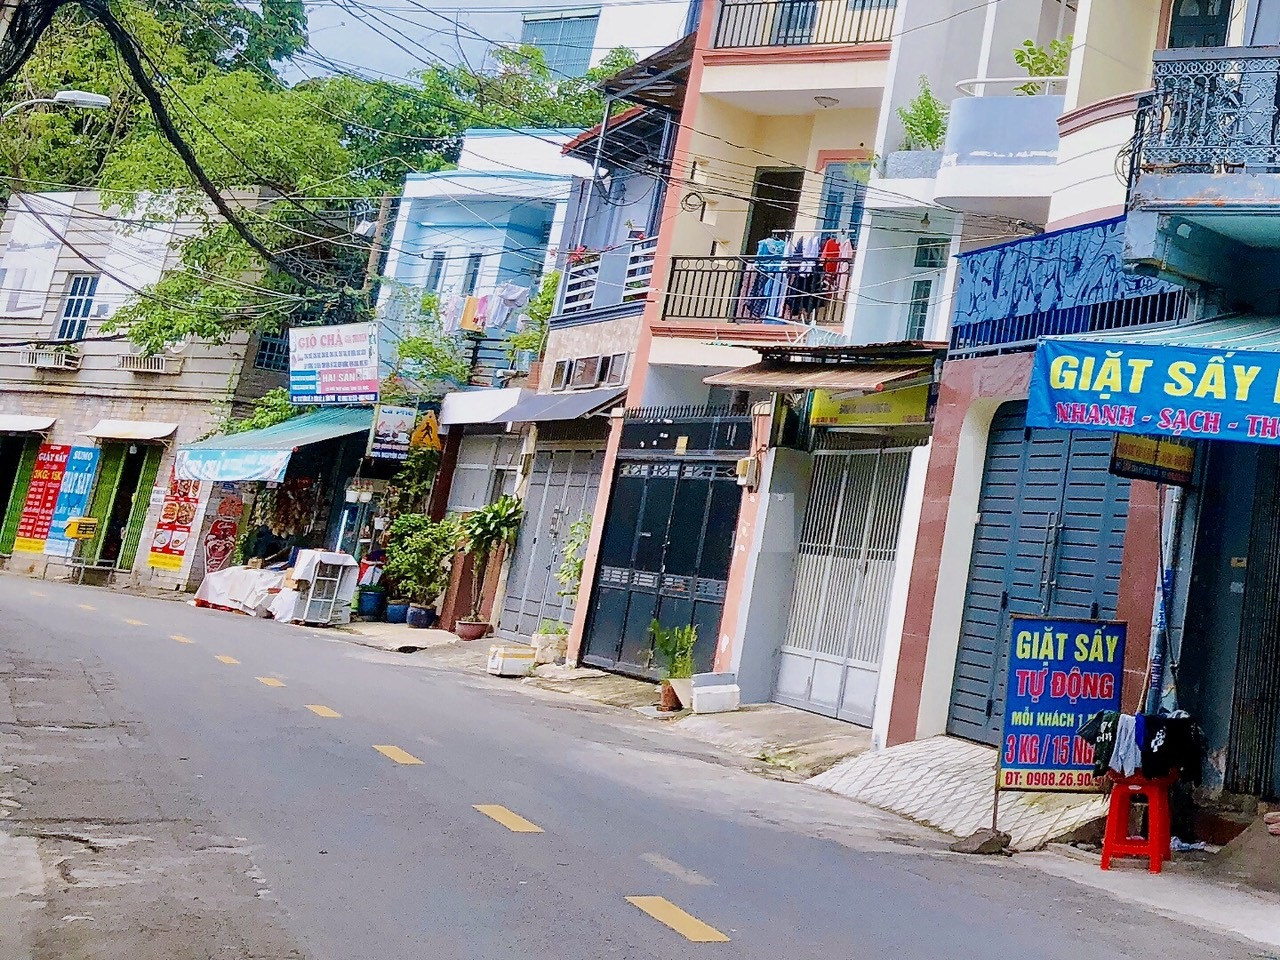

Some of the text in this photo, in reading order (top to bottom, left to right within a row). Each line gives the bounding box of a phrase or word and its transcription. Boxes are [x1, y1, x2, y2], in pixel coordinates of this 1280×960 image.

[1050, 349, 1154, 400] GIẶT
[1164, 352, 1262, 402] SẤY
[1055, 402, 1138, 427] NHANH
[1157, 408, 1222, 436] SẠCH
[1016, 625, 1119, 666] GIẶT SẤY
[1016, 667, 1050, 703] TỰ
[1050, 666, 1115, 704] ĐỘNG
[1011, 706, 1034, 726] MỖI
[1036, 709, 1075, 727] KHÁCH
[1004, 733, 1017, 764] 3
[1018, 734, 1039, 765] KG
[1052, 735, 1071, 766] 15
